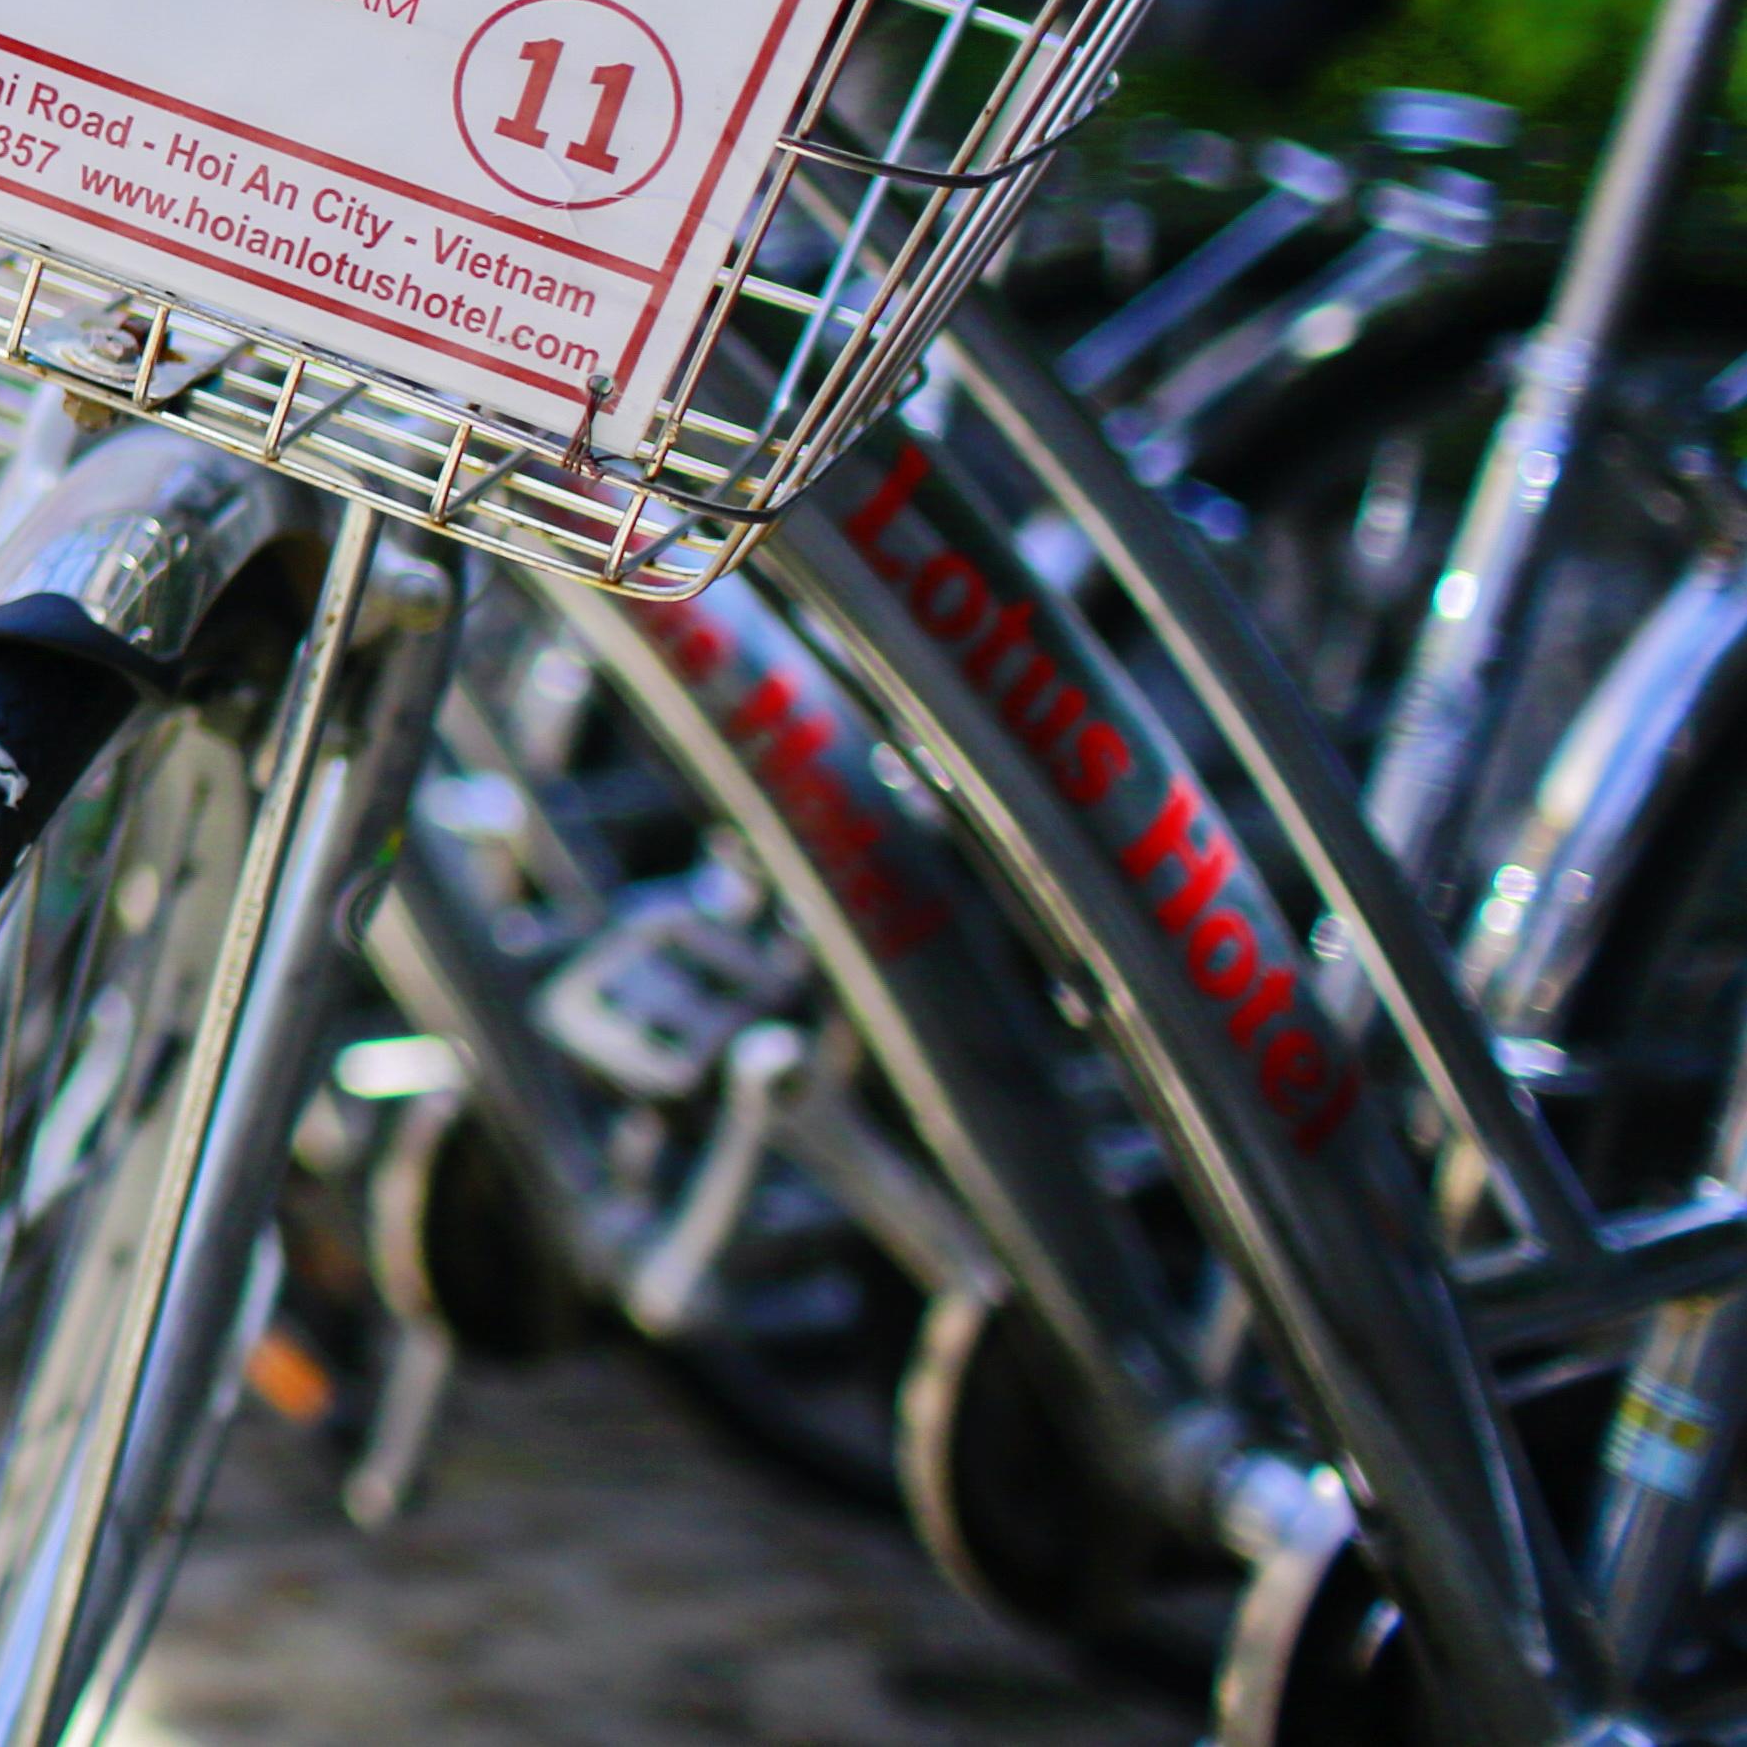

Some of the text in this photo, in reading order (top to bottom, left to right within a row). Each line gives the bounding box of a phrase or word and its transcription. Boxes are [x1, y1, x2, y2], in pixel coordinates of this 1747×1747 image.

[27, 81, 135, 149] Road
[165, 133, 238, 189] Hoi
[240, 164, 300, 211] An
[311, 187, 395, 250] City
[432, 226, 597, 318] Vietnam
[494, 36, 636, 175] 11
[81, 163, 601, 374] www.hoianlotushotel.com
[847, 438, 1364, 1159] Lotus Hotel
